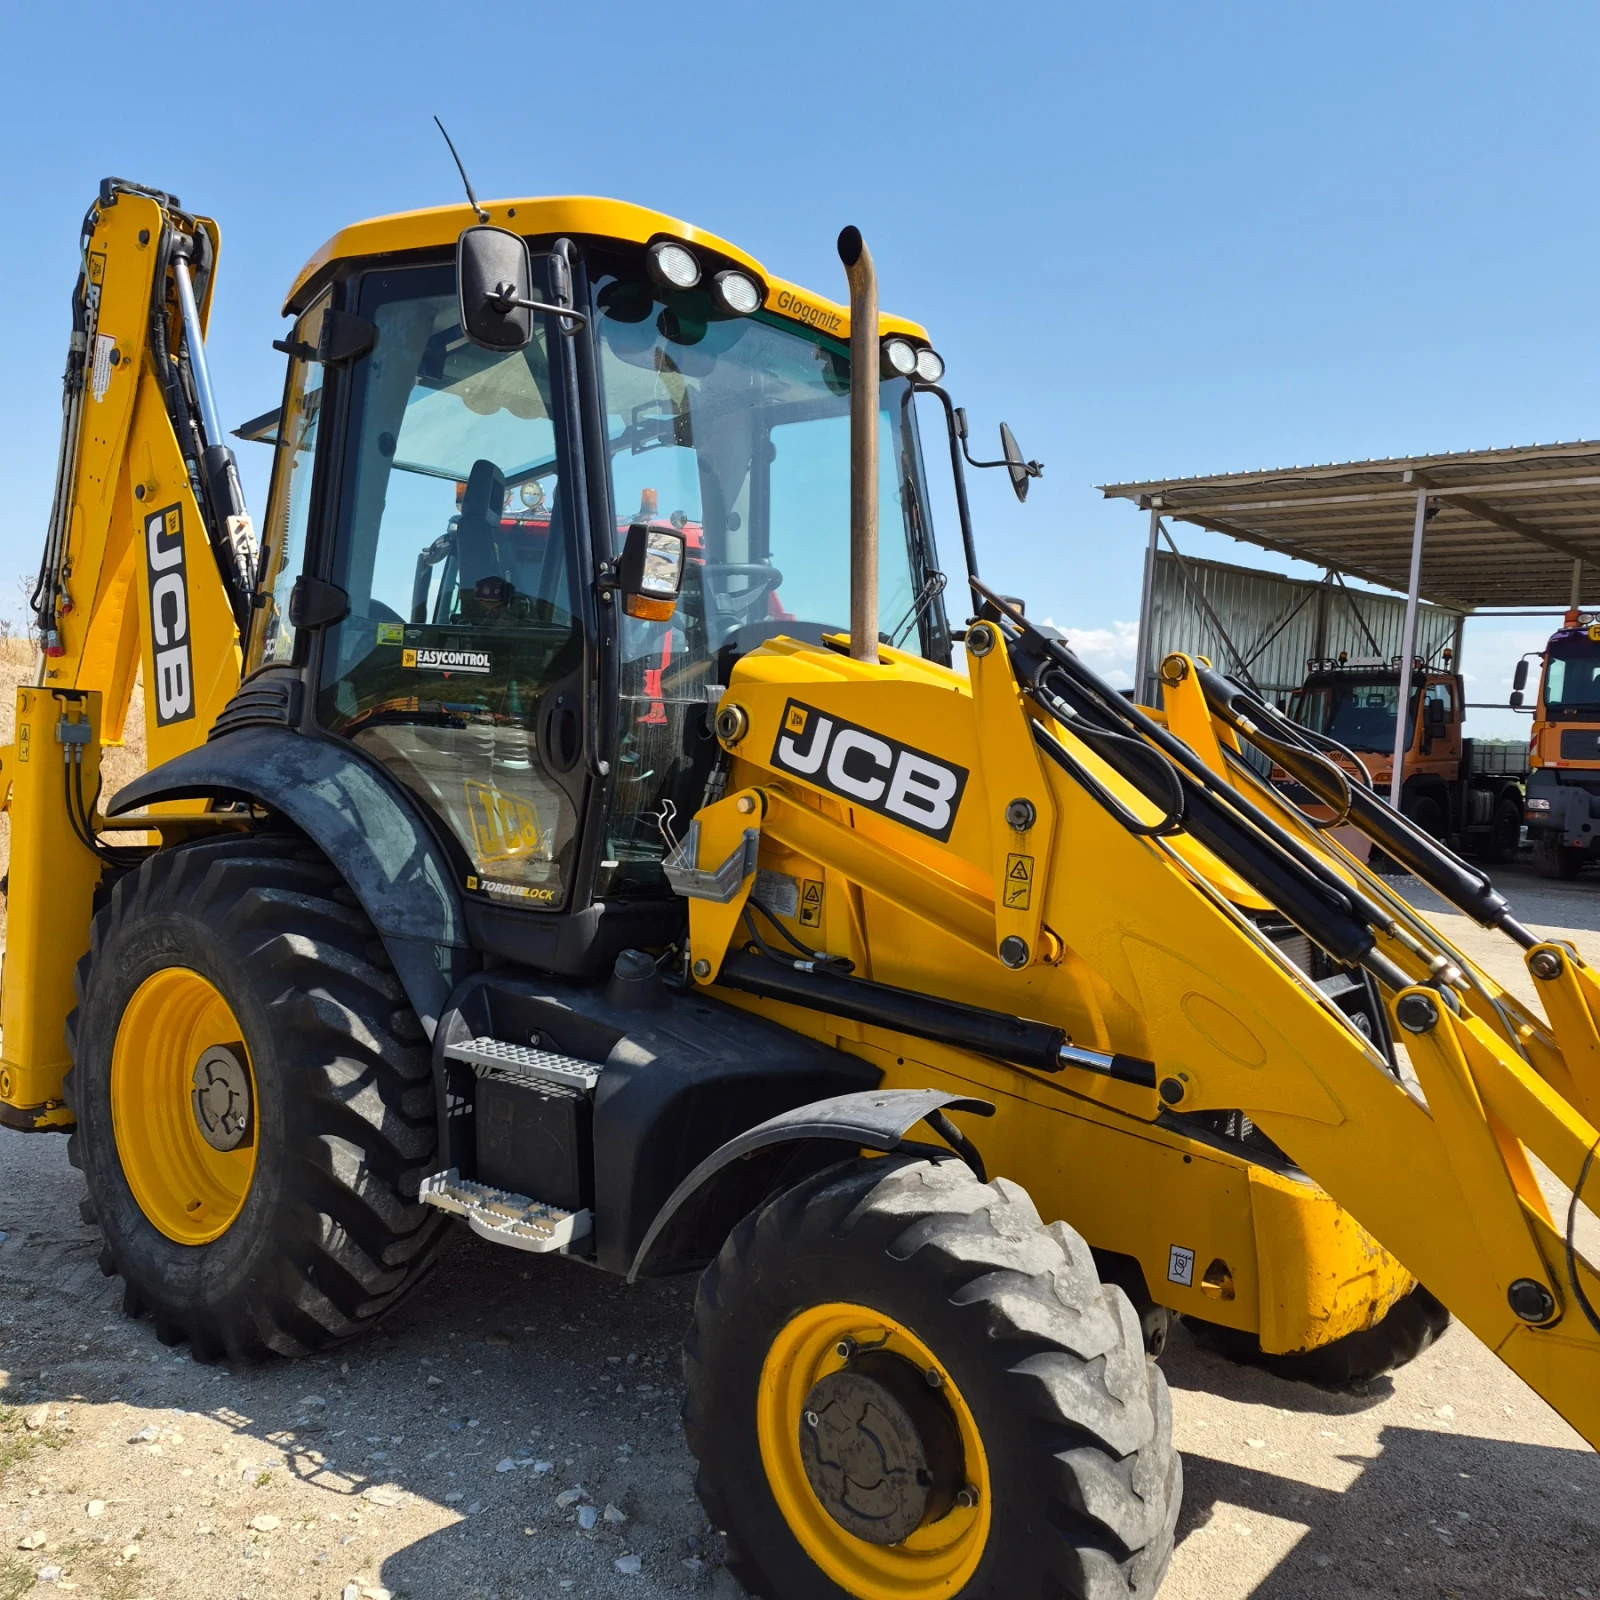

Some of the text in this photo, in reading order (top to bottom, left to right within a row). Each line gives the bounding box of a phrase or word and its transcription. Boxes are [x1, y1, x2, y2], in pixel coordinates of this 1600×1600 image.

[777, 290, 842, 331] Gloggnitz
[148, 515, 191, 720] JCB
[417, 650, 490, 668] EASYCONTROL
[779, 717, 957, 830] JCB
[478, 790, 537, 853] JCB
[481, 880, 555, 900] TORQUELOCK
